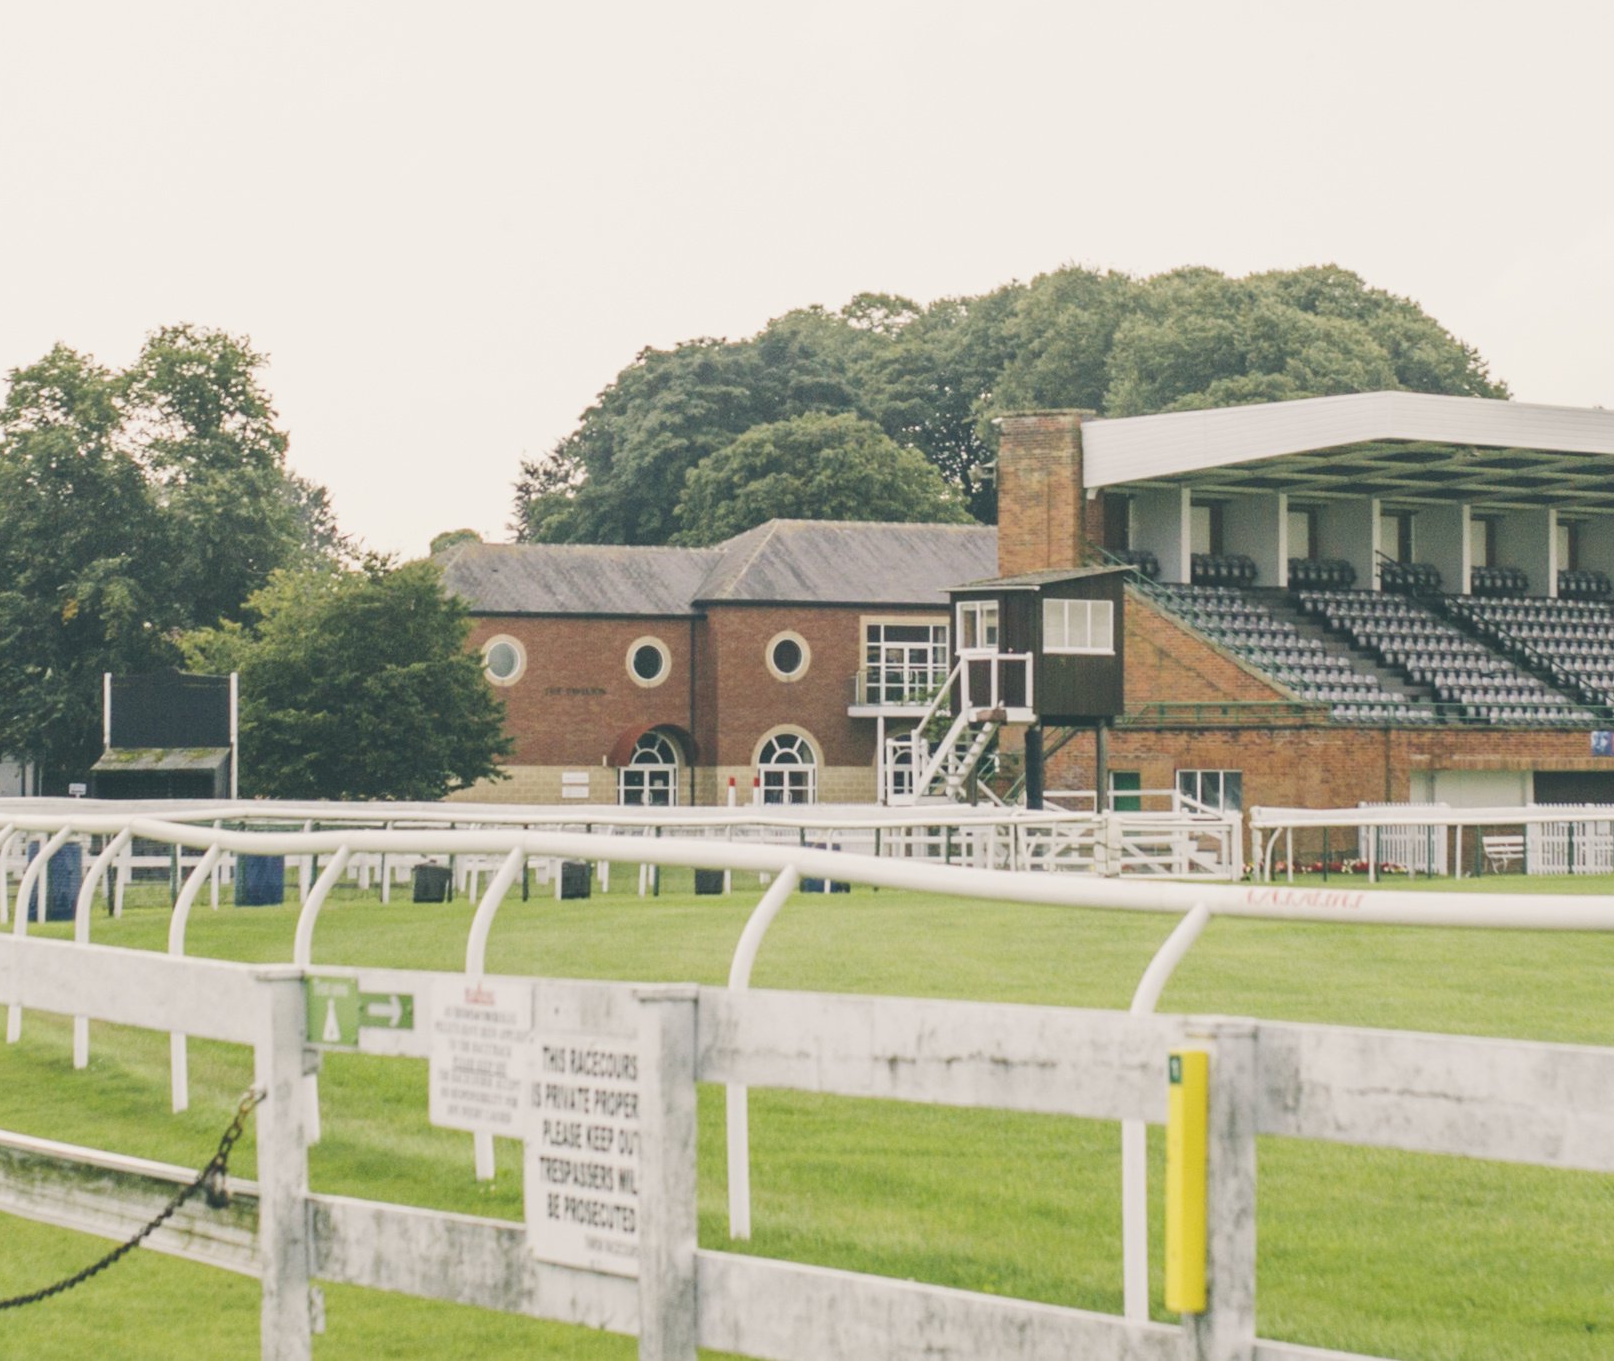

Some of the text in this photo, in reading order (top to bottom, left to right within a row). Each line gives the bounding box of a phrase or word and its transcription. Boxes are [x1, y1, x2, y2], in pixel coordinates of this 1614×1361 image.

[543, 1046, 565, 1073] THIS
[570, 1048, 638, 1080] RACECOURS
[531, 1082, 541, 1108] IS
[546, 1084, 589, 1114] PRIVATE
[594, 1089, 639, 1118] PROPER
[543, 1119, 582, 1150] PLEASE
[587, 1125, 614, 1152] KEEP
[539, 1156, 638, 1195] TRESPASSERS WIL
[548, 1193, 636, 1233] BE PROSECUTED
